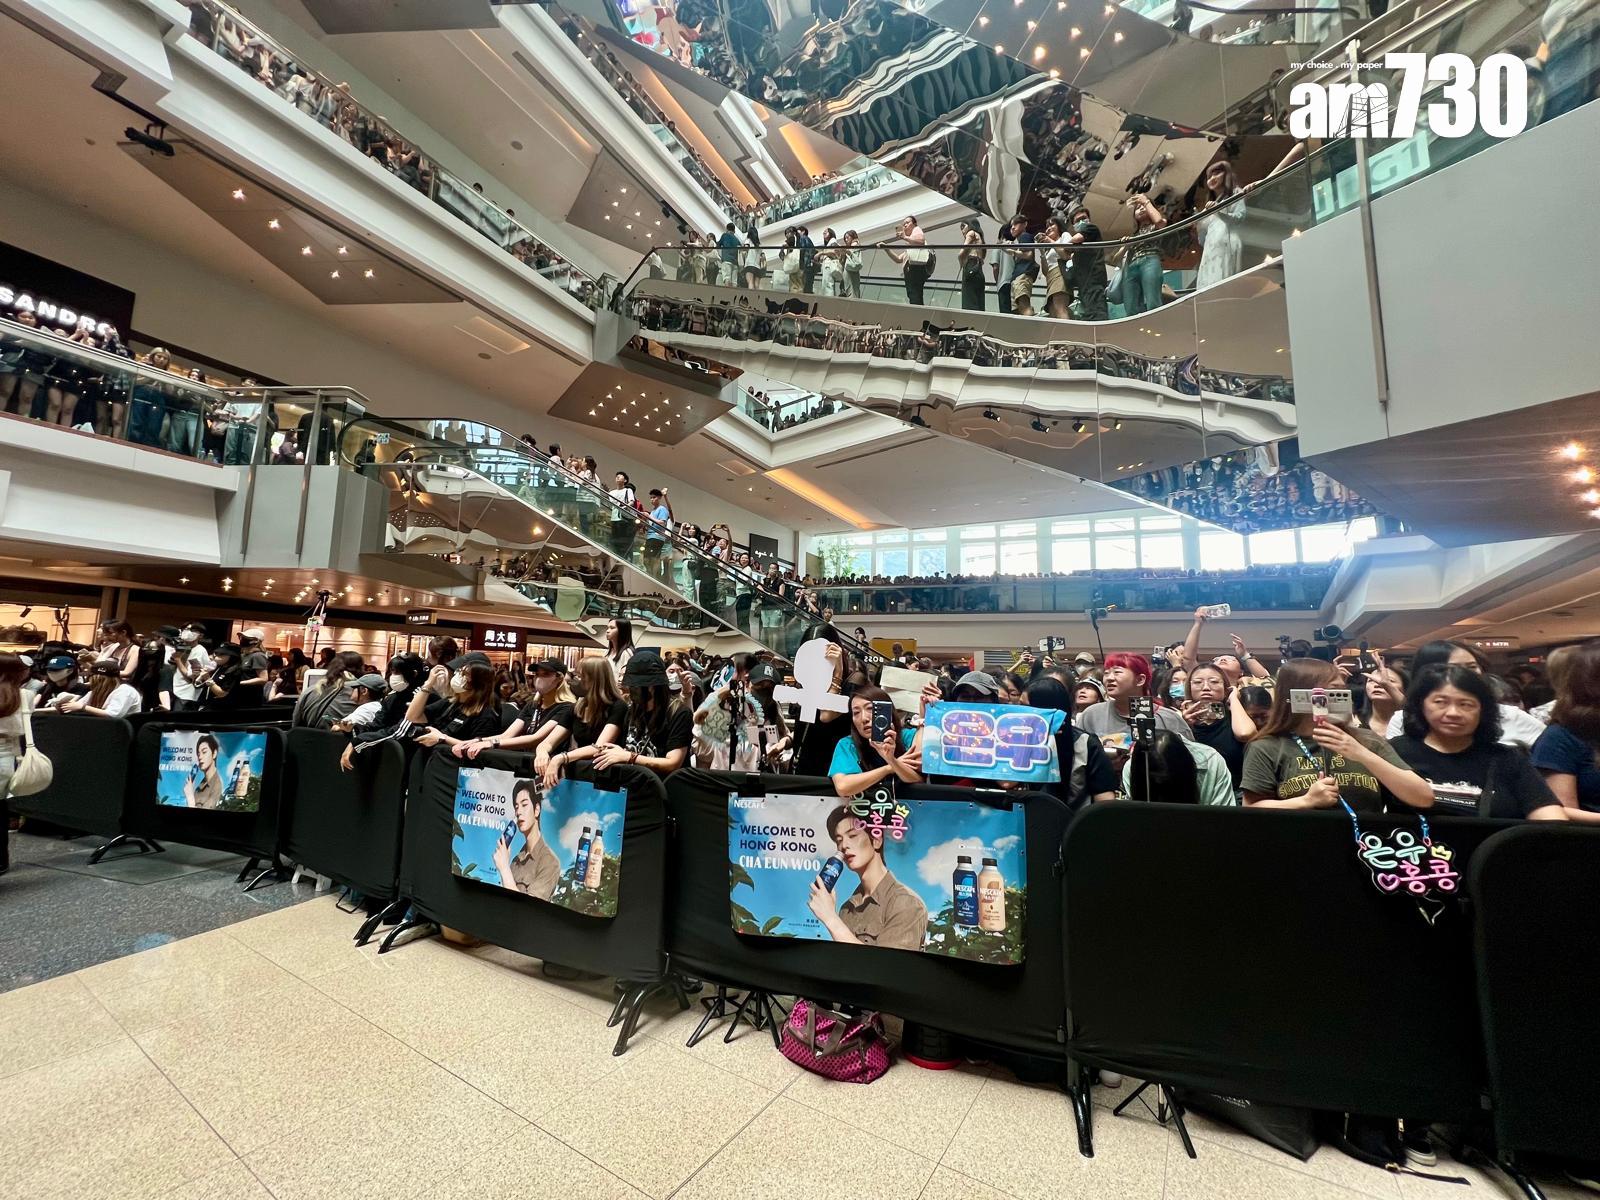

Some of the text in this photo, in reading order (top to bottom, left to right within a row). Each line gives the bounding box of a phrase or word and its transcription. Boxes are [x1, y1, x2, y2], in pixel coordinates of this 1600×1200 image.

[461, 789, 506, 804] WELCOME TO
[459, 801, 506, 816] HONG KONG
[457, 813, 506, 832] CHA EUN WOO
[740, 825, 815, 838] WELCOME TO
[740, 839, 817, 854] HONG KONG
[1362, 831, 1428, 869] 은우
[739, 855, 763, 869] CHA
[764, 856, 789, 870] EUN
[789, 857, 821, 872] WOO
[1399, 859, 1459, 893] 홍콩
